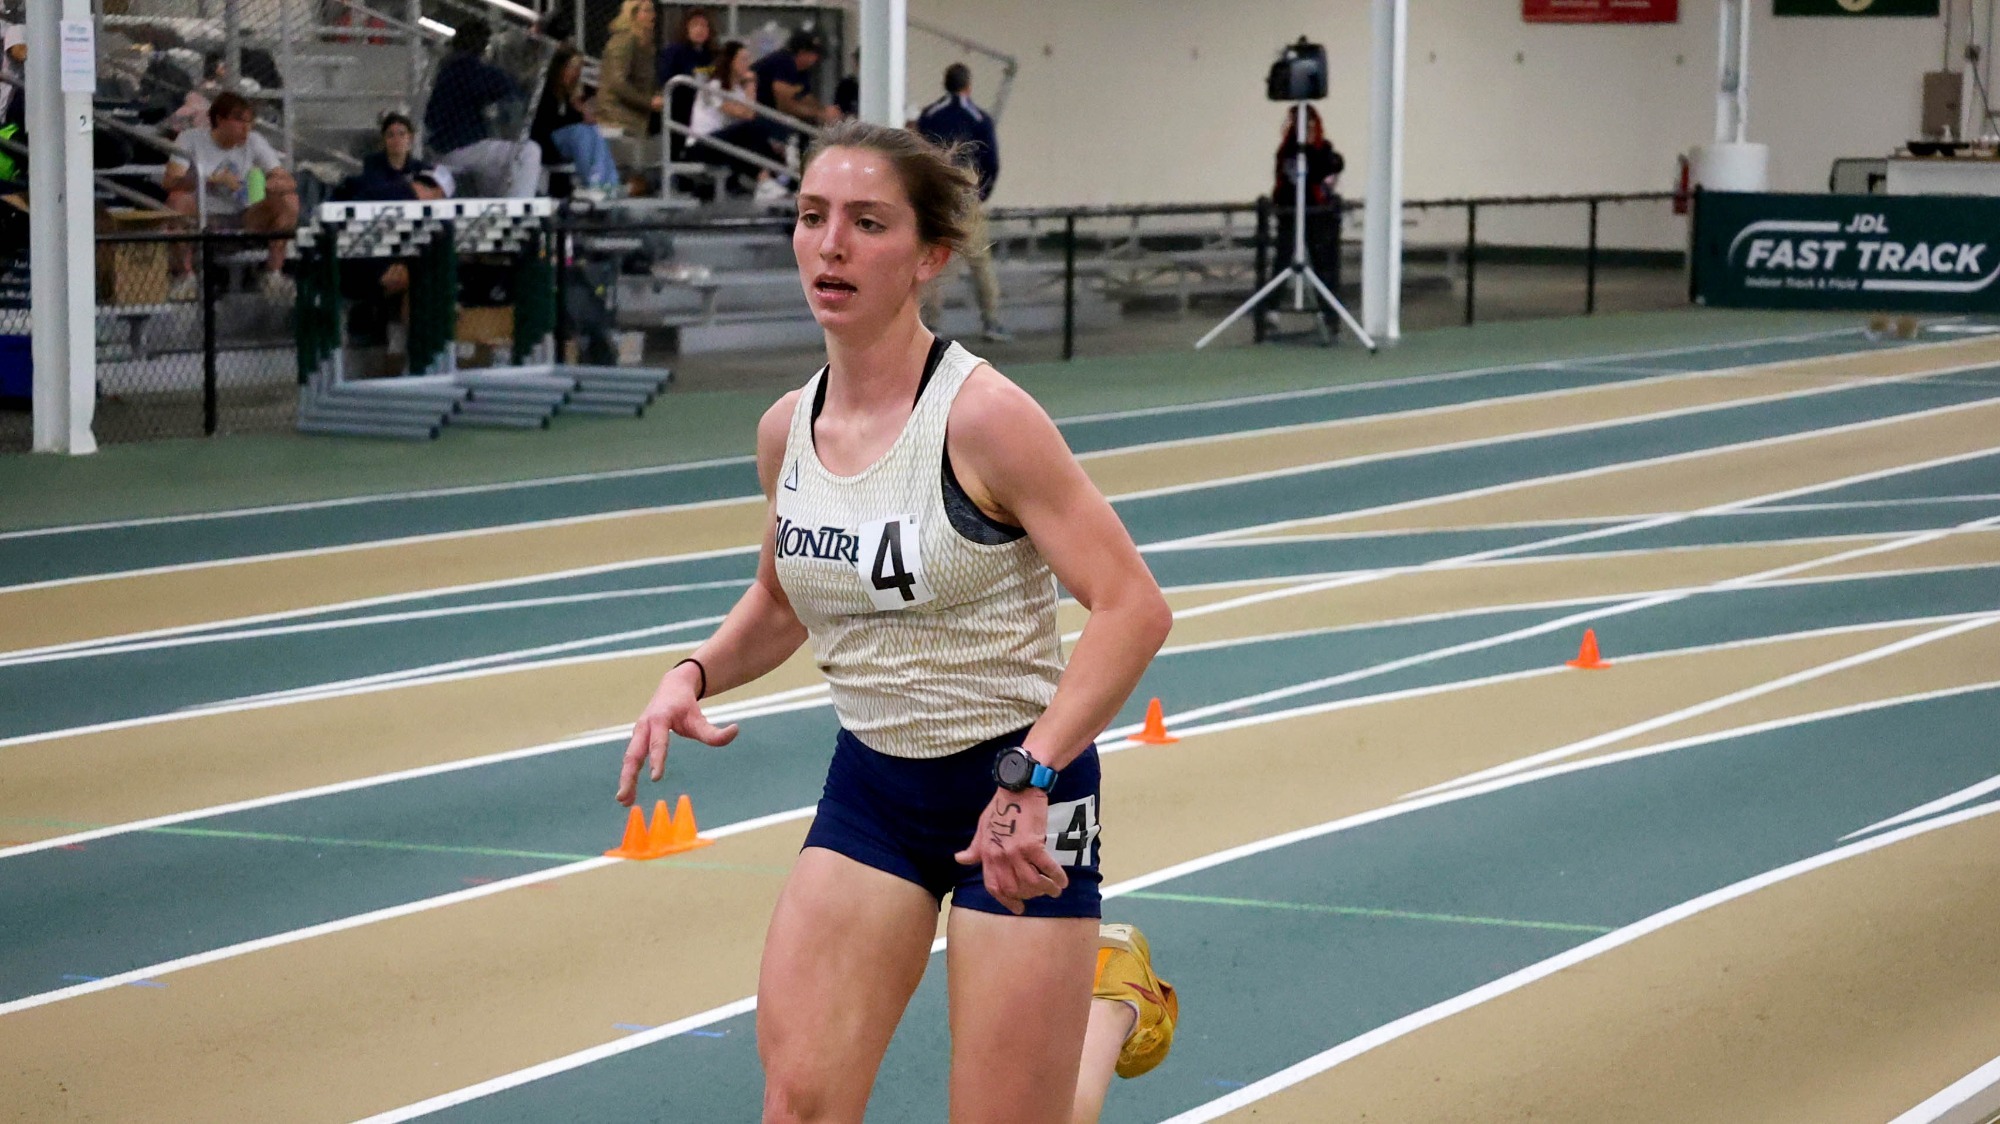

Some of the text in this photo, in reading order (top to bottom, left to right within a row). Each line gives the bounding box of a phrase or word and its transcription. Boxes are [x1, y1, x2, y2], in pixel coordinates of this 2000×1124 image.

[1845, 213, 1889, 234] JDL
[1746, 239, 1986, 273] FAST TRACK
[871, 520, 916, 602] 4
[1055, 803, 1089, 867] 4
